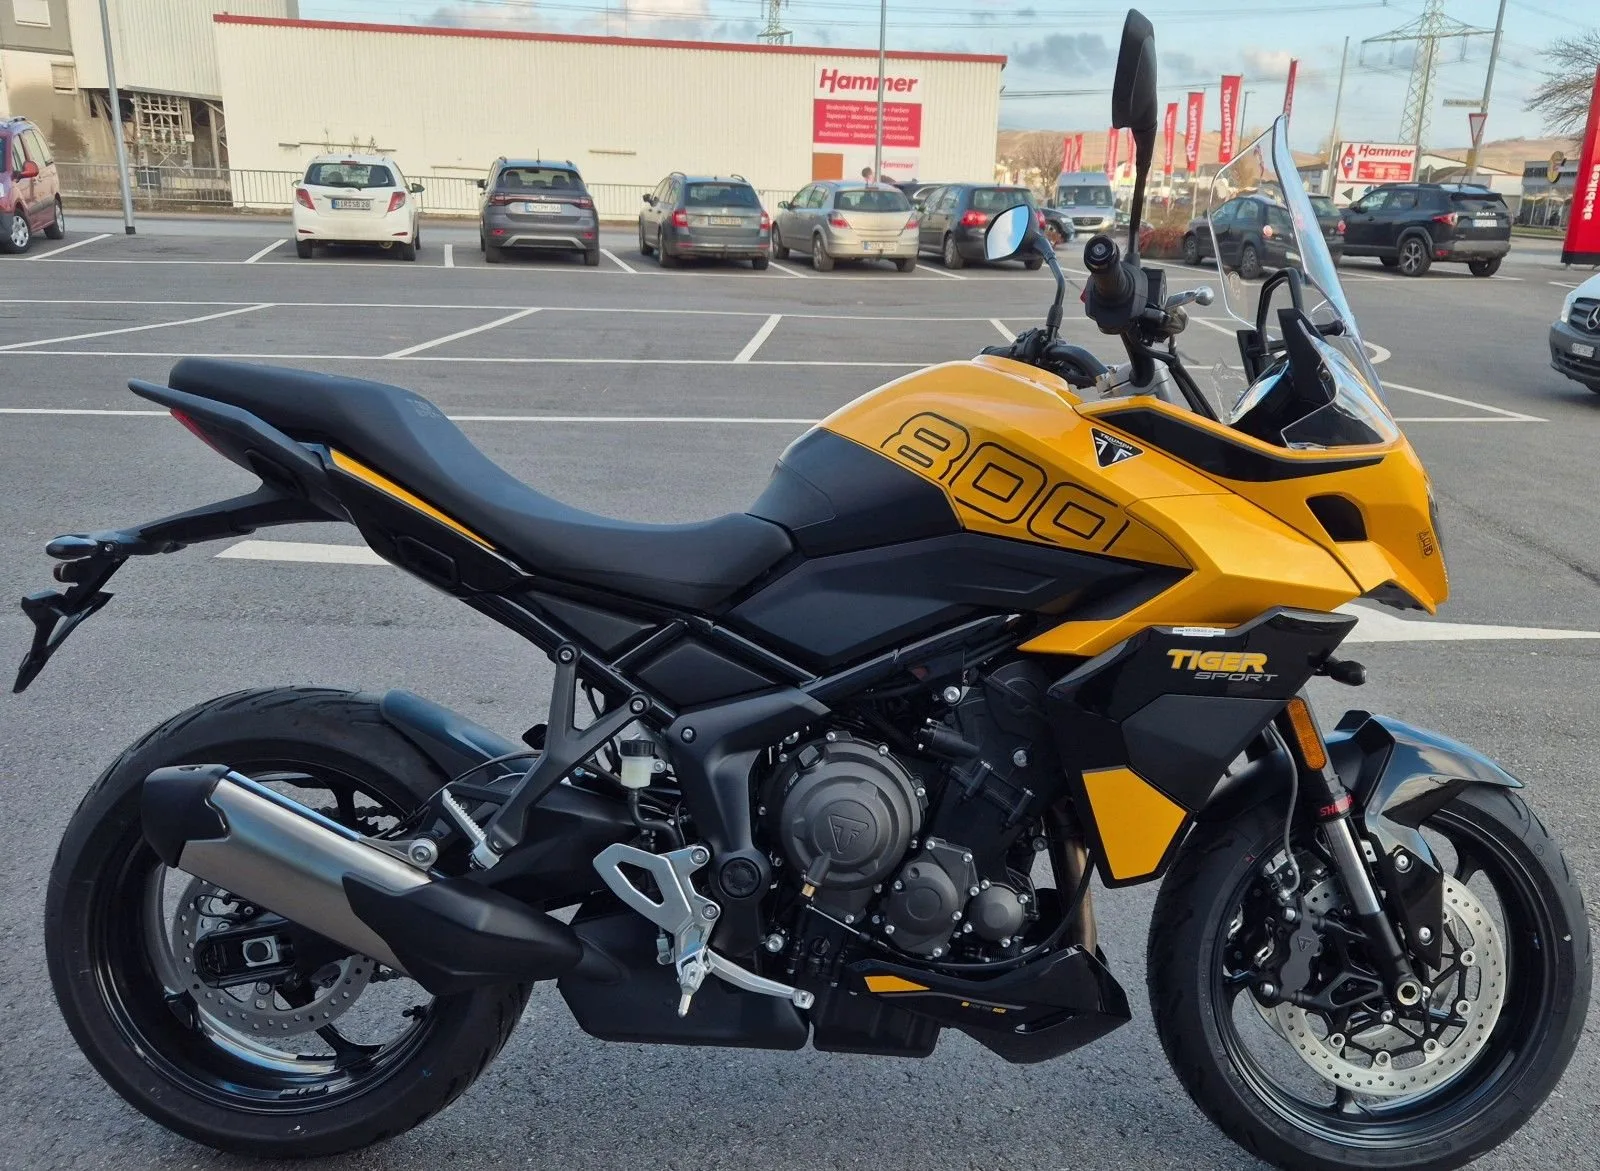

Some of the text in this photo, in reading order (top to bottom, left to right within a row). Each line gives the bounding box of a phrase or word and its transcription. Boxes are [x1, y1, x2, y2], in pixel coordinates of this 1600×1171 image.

[820, 68, 918, 93] Hammer
[1358, 144, 1415, 158] Hammer
[1582, 164, 1600, 220] sk-bikes
[1100, 432, 1133, 451] TRIUMPH
[880, 411, 1130, 552] 800
[1166, 648, 1268, 673] TIGER
[1194, 671, 1279, 682] SPORT
